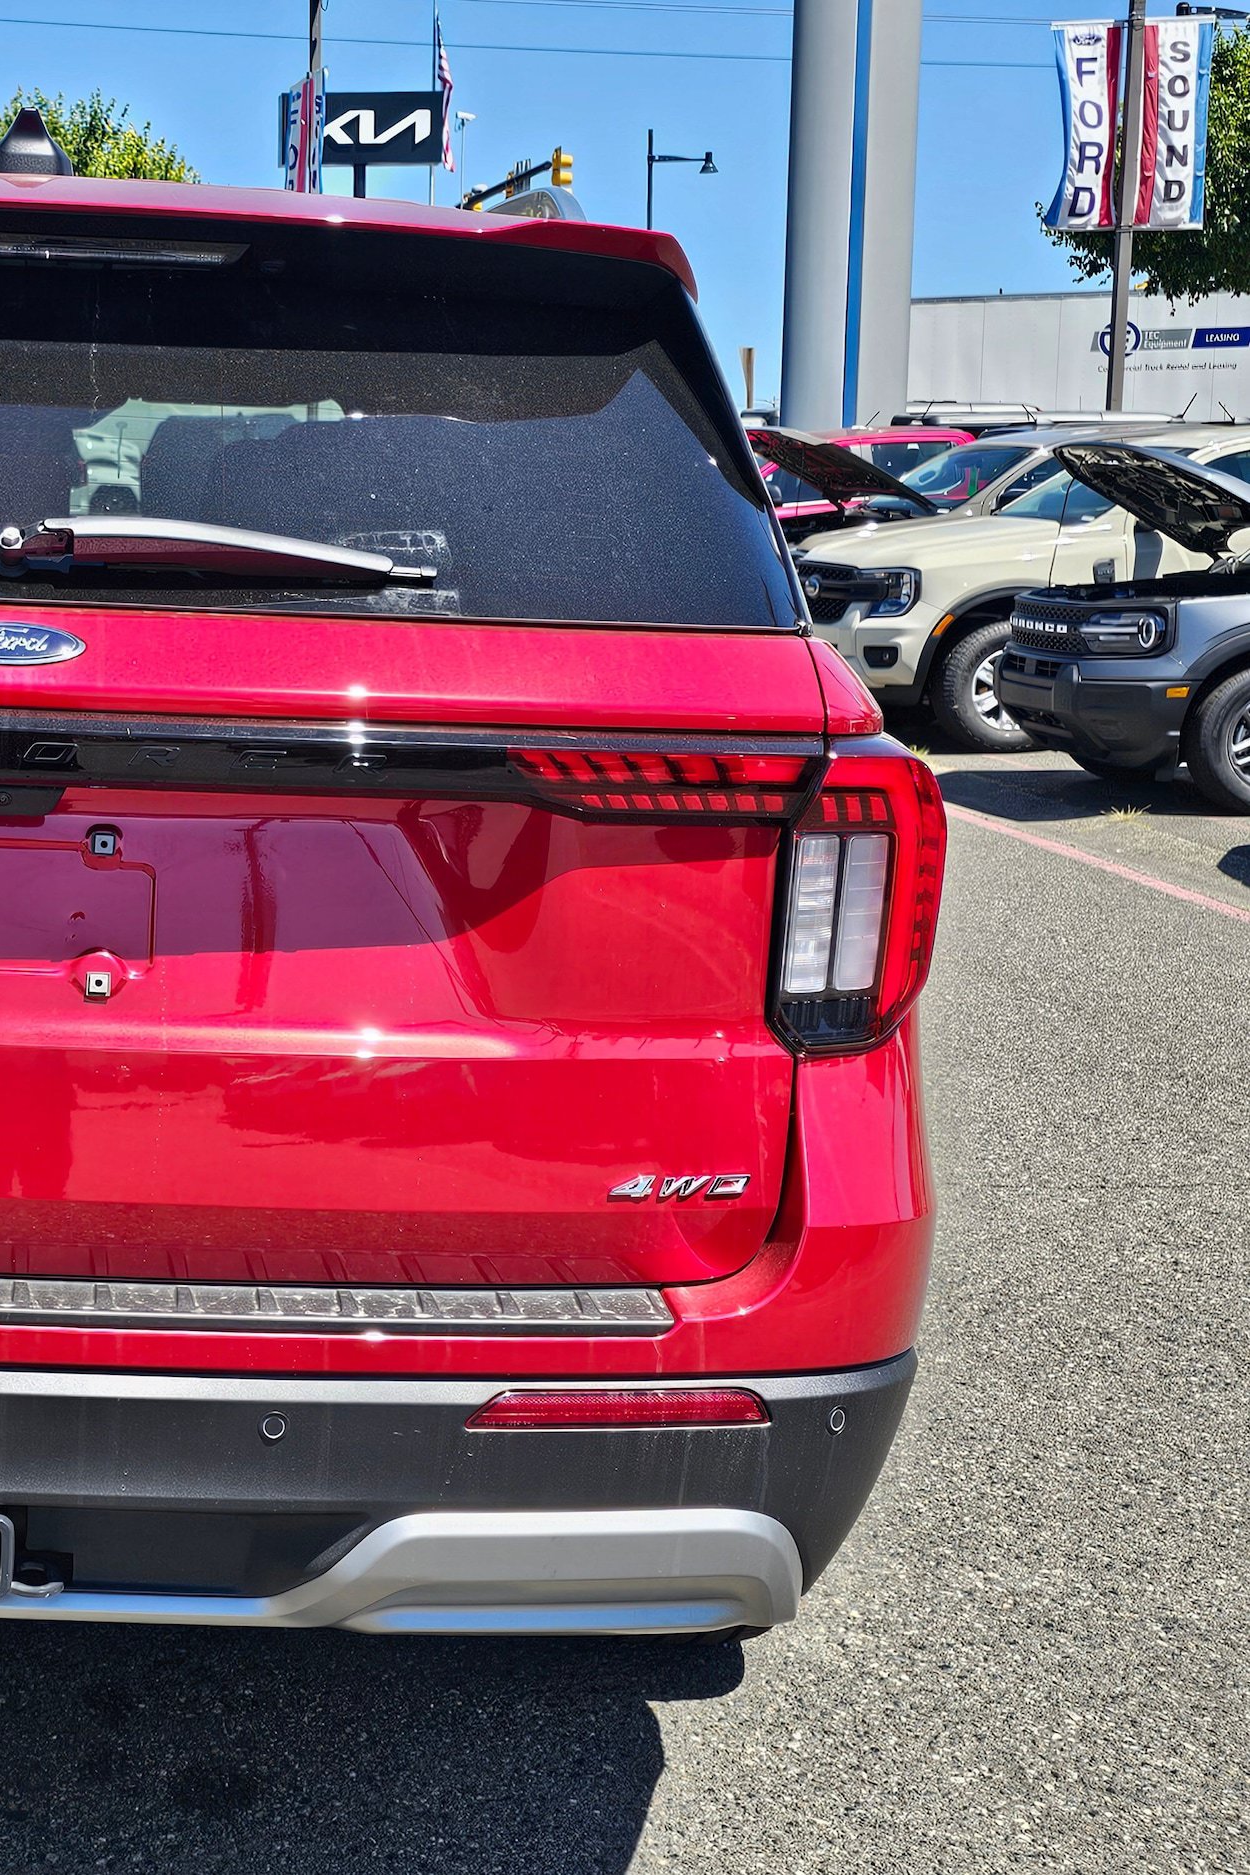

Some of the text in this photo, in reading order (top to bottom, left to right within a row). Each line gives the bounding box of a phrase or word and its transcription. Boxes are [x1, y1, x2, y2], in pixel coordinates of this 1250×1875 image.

[1068, 57, 1104, 217] FORD
[1162, 40, 1191, 203] SOUND
[1010, 616, 1068, 634] BRONCO
[609, 1174, 751, 1198] 4WD
